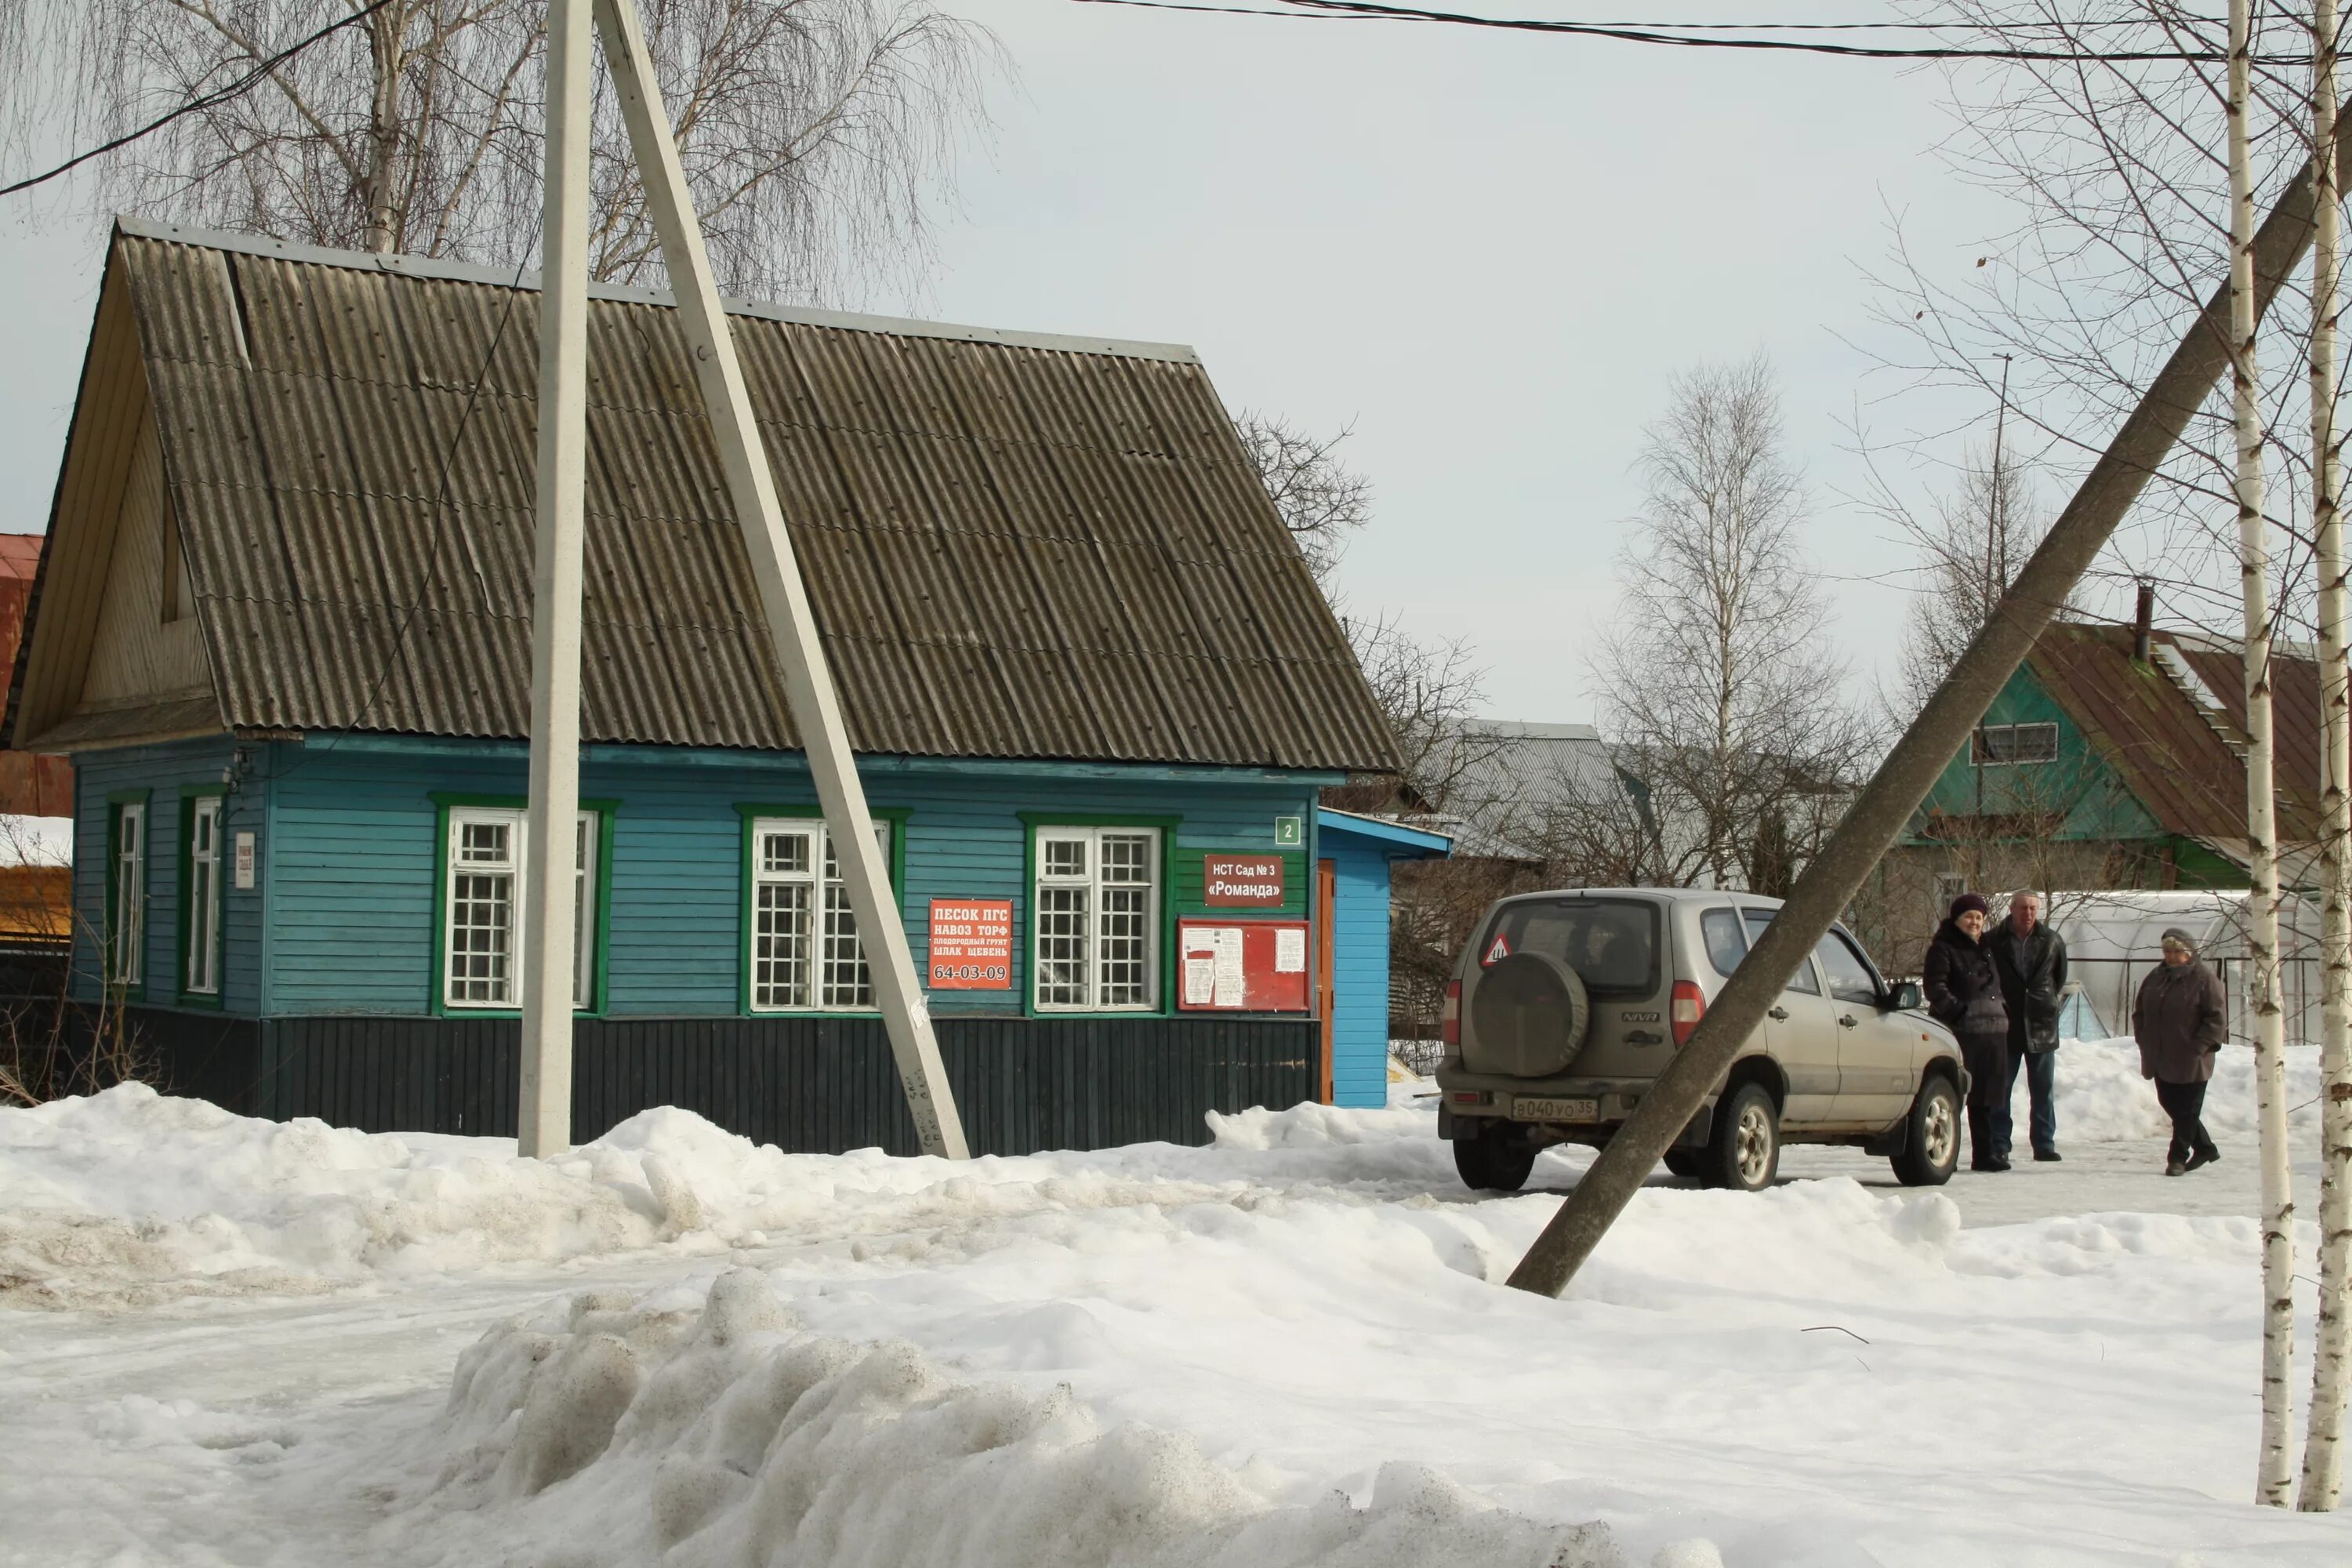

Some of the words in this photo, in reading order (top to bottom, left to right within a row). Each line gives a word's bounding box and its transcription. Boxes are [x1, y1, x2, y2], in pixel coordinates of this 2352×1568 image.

[1284, 824, 1292, 838] 2
[1213, 864, 1233, 875] НСТ
[1236, 864, 1254, 877] Сад
[1256, 865, 1268, 876] №
[1269, 865, 1276, 876] 3
[1208, 881, 1280, 898] «Романда»
[935, 908, 979, 920] ПЕСОК
[982, 909, 1007, 921] ПГС
[934, 925, 972, 935] НАВОЗ
[978, 925, 1008, 936] ТОРФ
[934, 947, 962, 956] ШЛАК
[967, 947, 1007, 957] ЩЕБЕНЬ
[934, 965, 1006, 980] 64-03-09
[1622, 1013, 1658, 1022] NIVA
